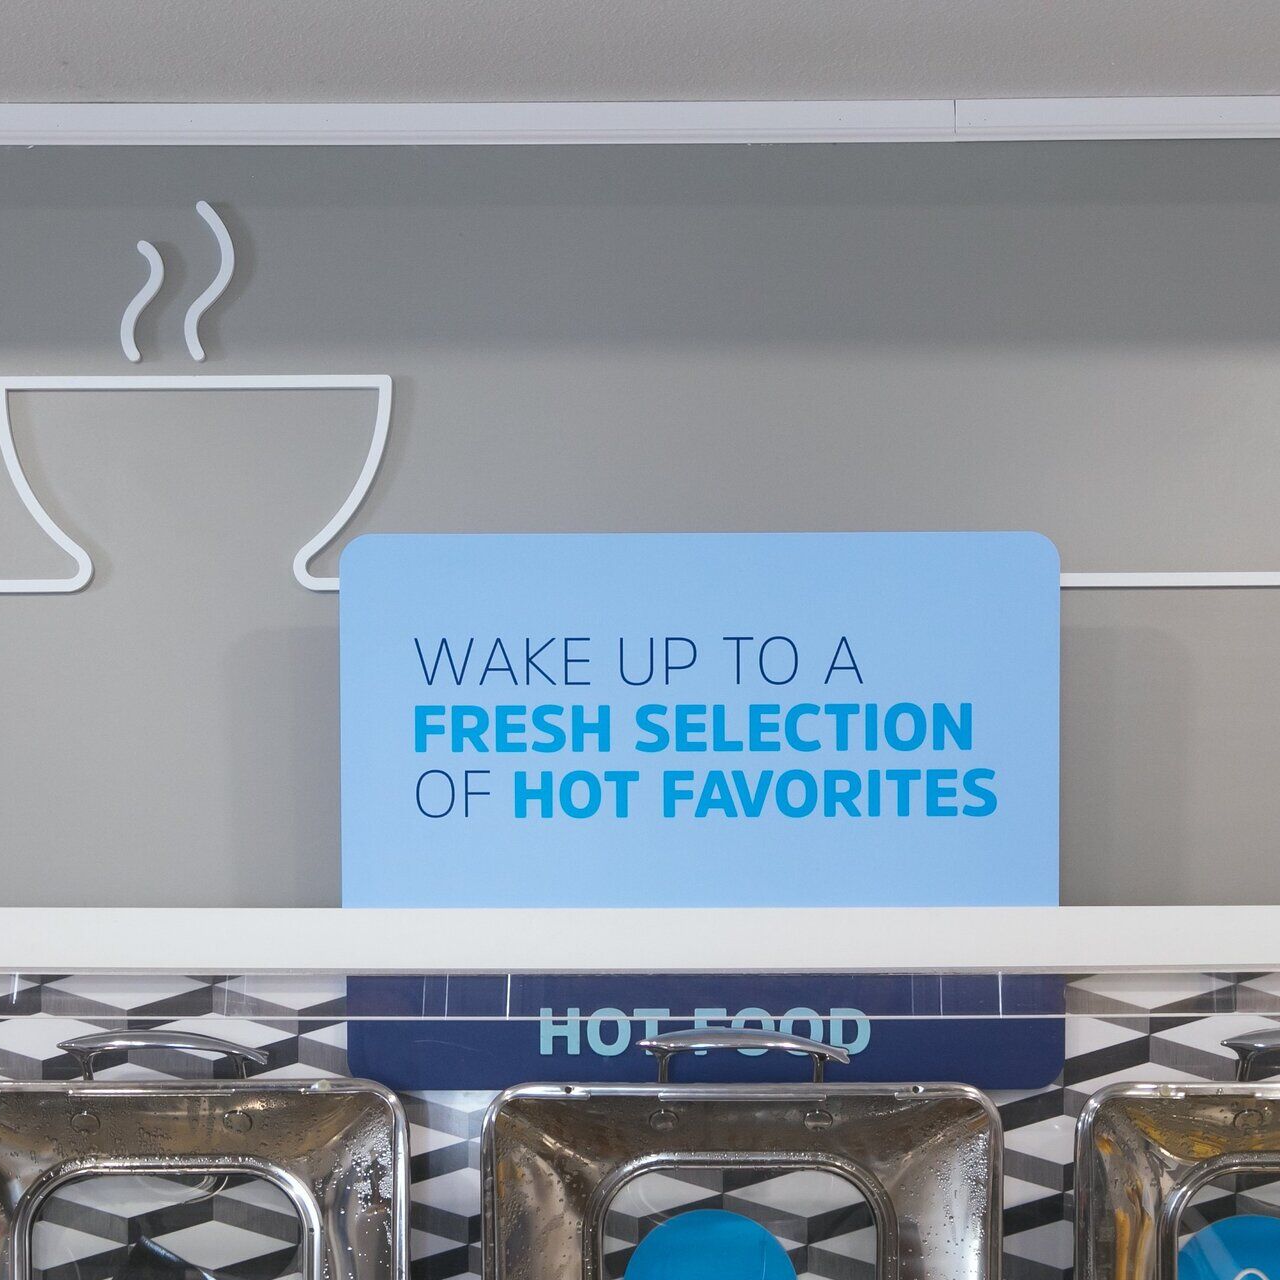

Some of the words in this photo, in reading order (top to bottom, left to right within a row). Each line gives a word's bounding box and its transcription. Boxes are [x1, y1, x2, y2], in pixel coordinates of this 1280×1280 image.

[413, 637, 591, 686] WAKE
[620, 637, 698, 686] UP
[723, 636, 799, 686] TO
[823, 636, 864, 685] A
[414, 704, 611, 753] FRESH
[635, 702, 973, 752] SELECTION
[415, 769, 491, 819] OF
[514, 770, 640, 819] HOT
[663, 768, 998, 818] FAVORITES
[539, 1007, 670, 1056] HOT
